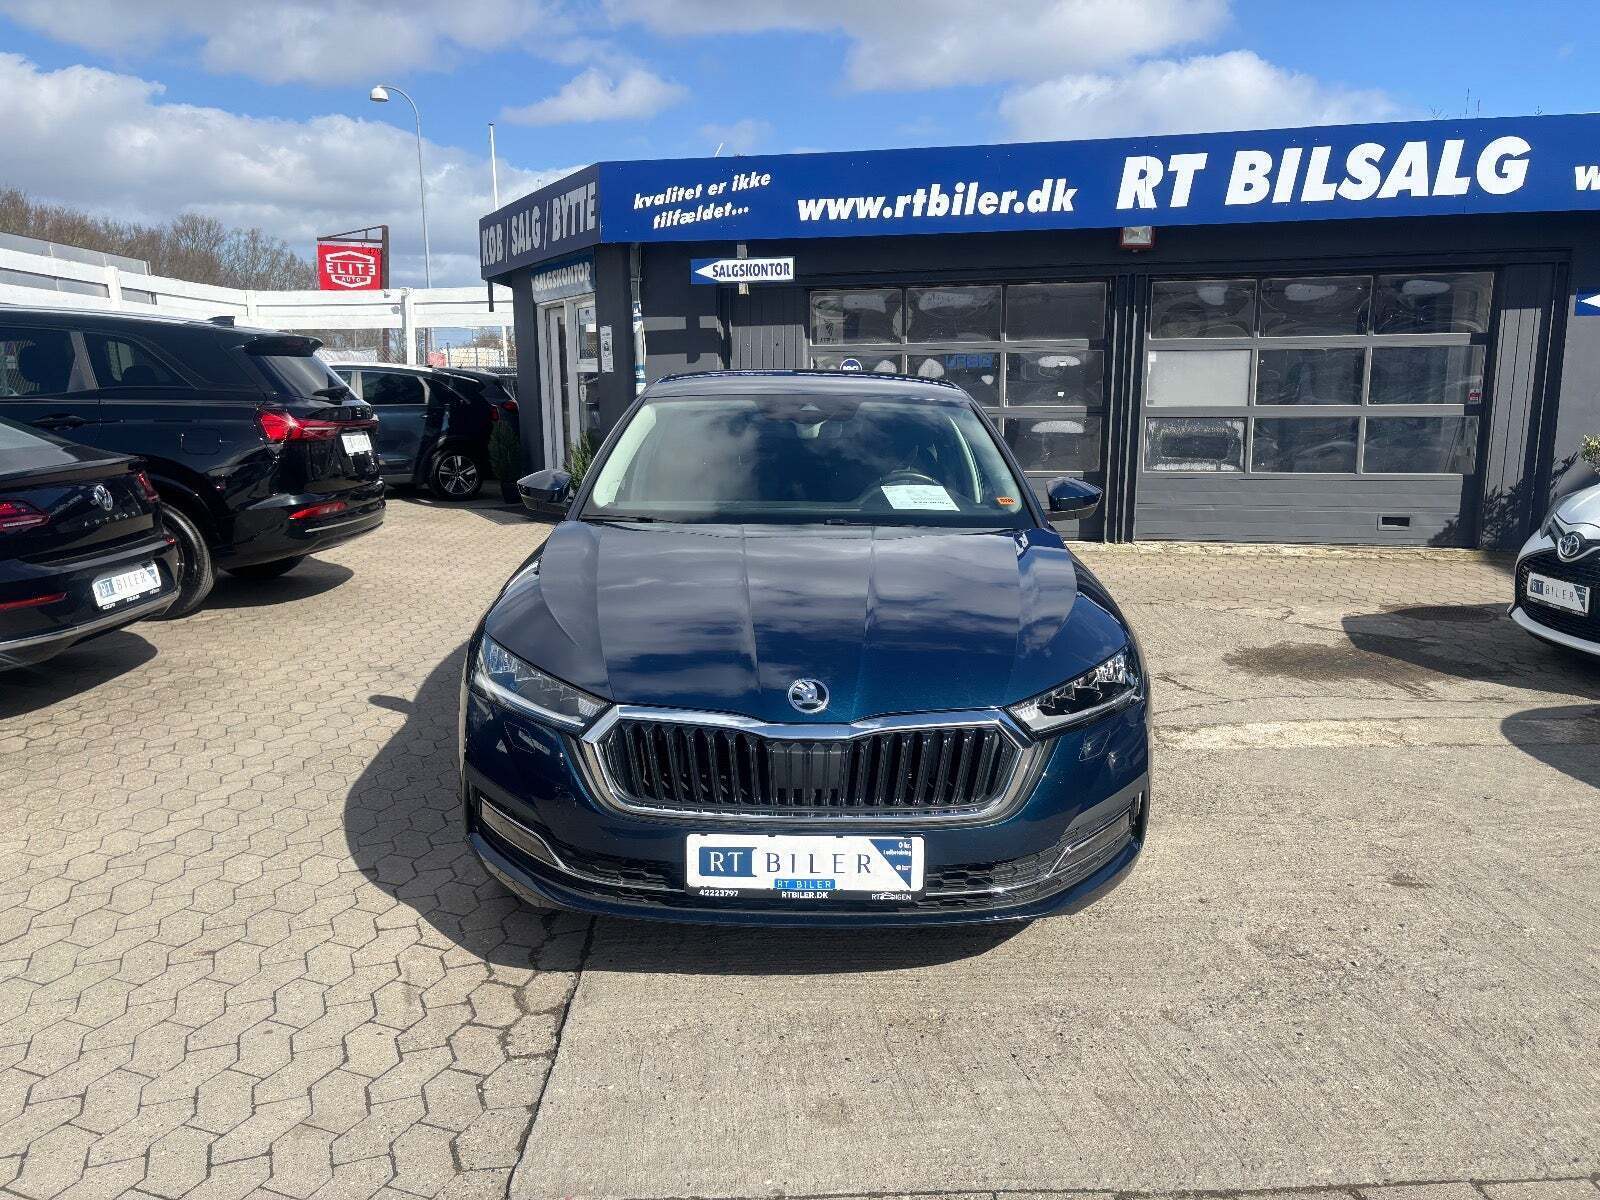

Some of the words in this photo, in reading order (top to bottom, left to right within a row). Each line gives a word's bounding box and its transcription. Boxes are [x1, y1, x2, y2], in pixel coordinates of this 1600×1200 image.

[1115, 153, 1208, 210] RT
[1225, 136, 1532, 206] BILSALG
[633, 184, 702, 210] kvalitet
[707, 182, 727, 196] er
[731, 171, 771, 192] ikke
[798, 178, 1078, 221] www.rtbiler.dk
[511, 205, 541, 256] SALG
[552, 181, 595, 242] BYTTE
[653, 202, 749, 229] tilfældet...
[326, 262, 376, 275] ELITE
[534, 261, 591, 292] SALGSKONTOR
[712, 263, 790, 278] SALGSKONTOR
[1532, 580, 1542, 591] RT
[1545, 585, 1574, 602] BILER
[709, 852, 744, 872] RT
[766, 852, 872, 874] BILER
[699, 889, 739, 897] 42223797
[777, 880, 789, 888] RT
[781, 891, 829, 899] RTBILER.DK
